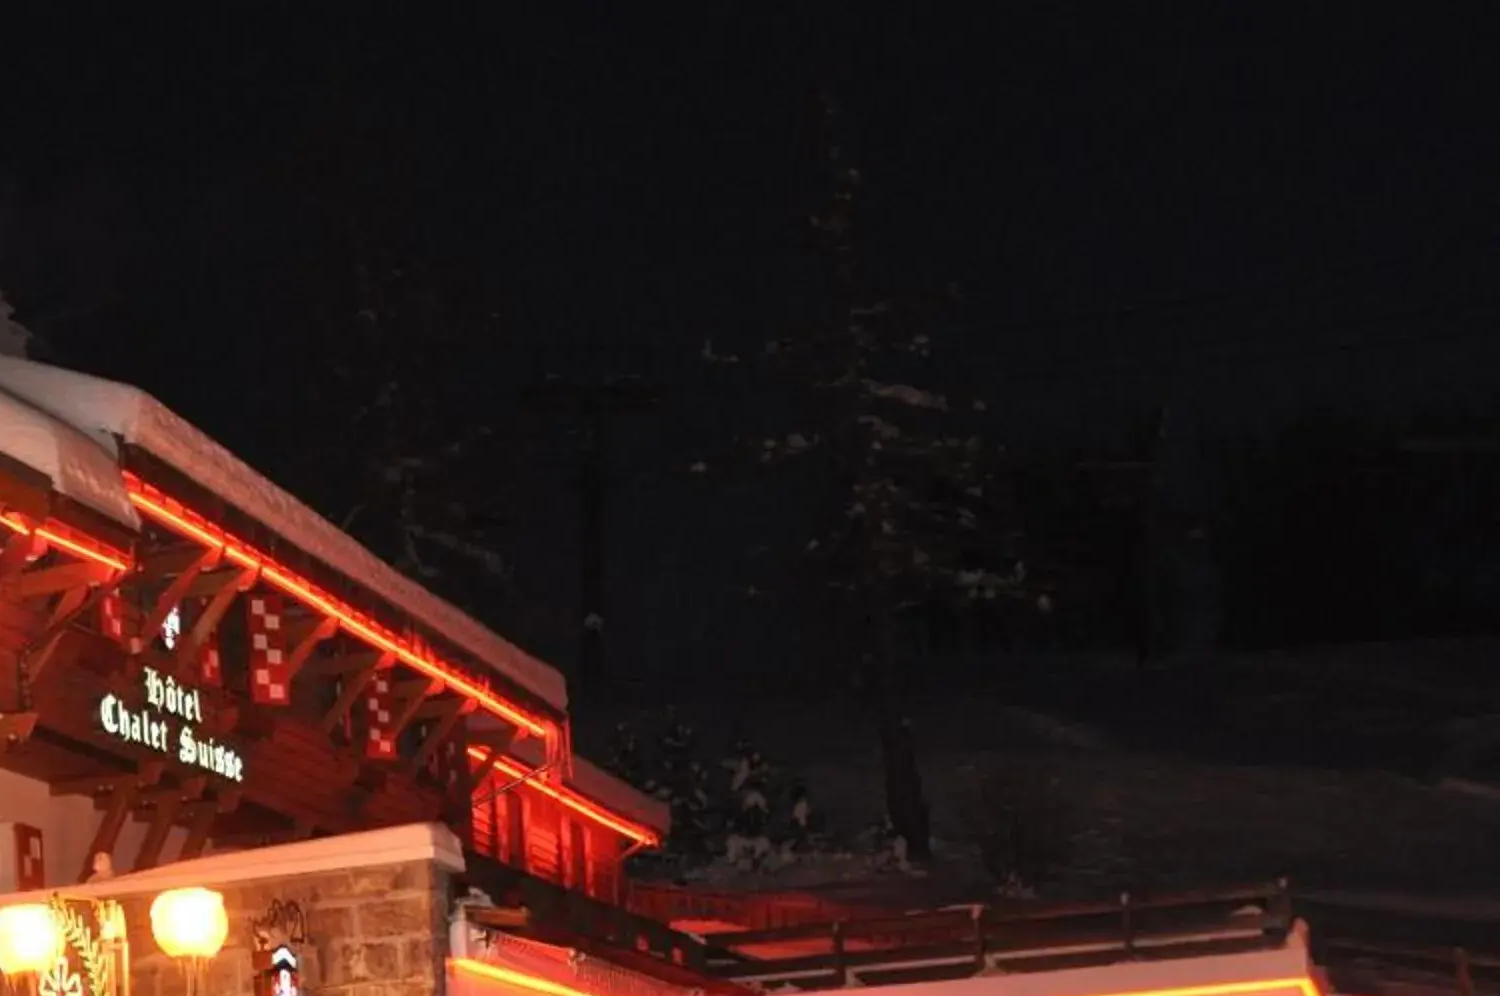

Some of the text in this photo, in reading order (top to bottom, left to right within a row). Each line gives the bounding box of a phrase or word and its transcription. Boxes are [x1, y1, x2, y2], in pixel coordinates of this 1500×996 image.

[144, 665, 203, 723] Hôtel
[100, 692, 243, 783] Chalet Suisse
